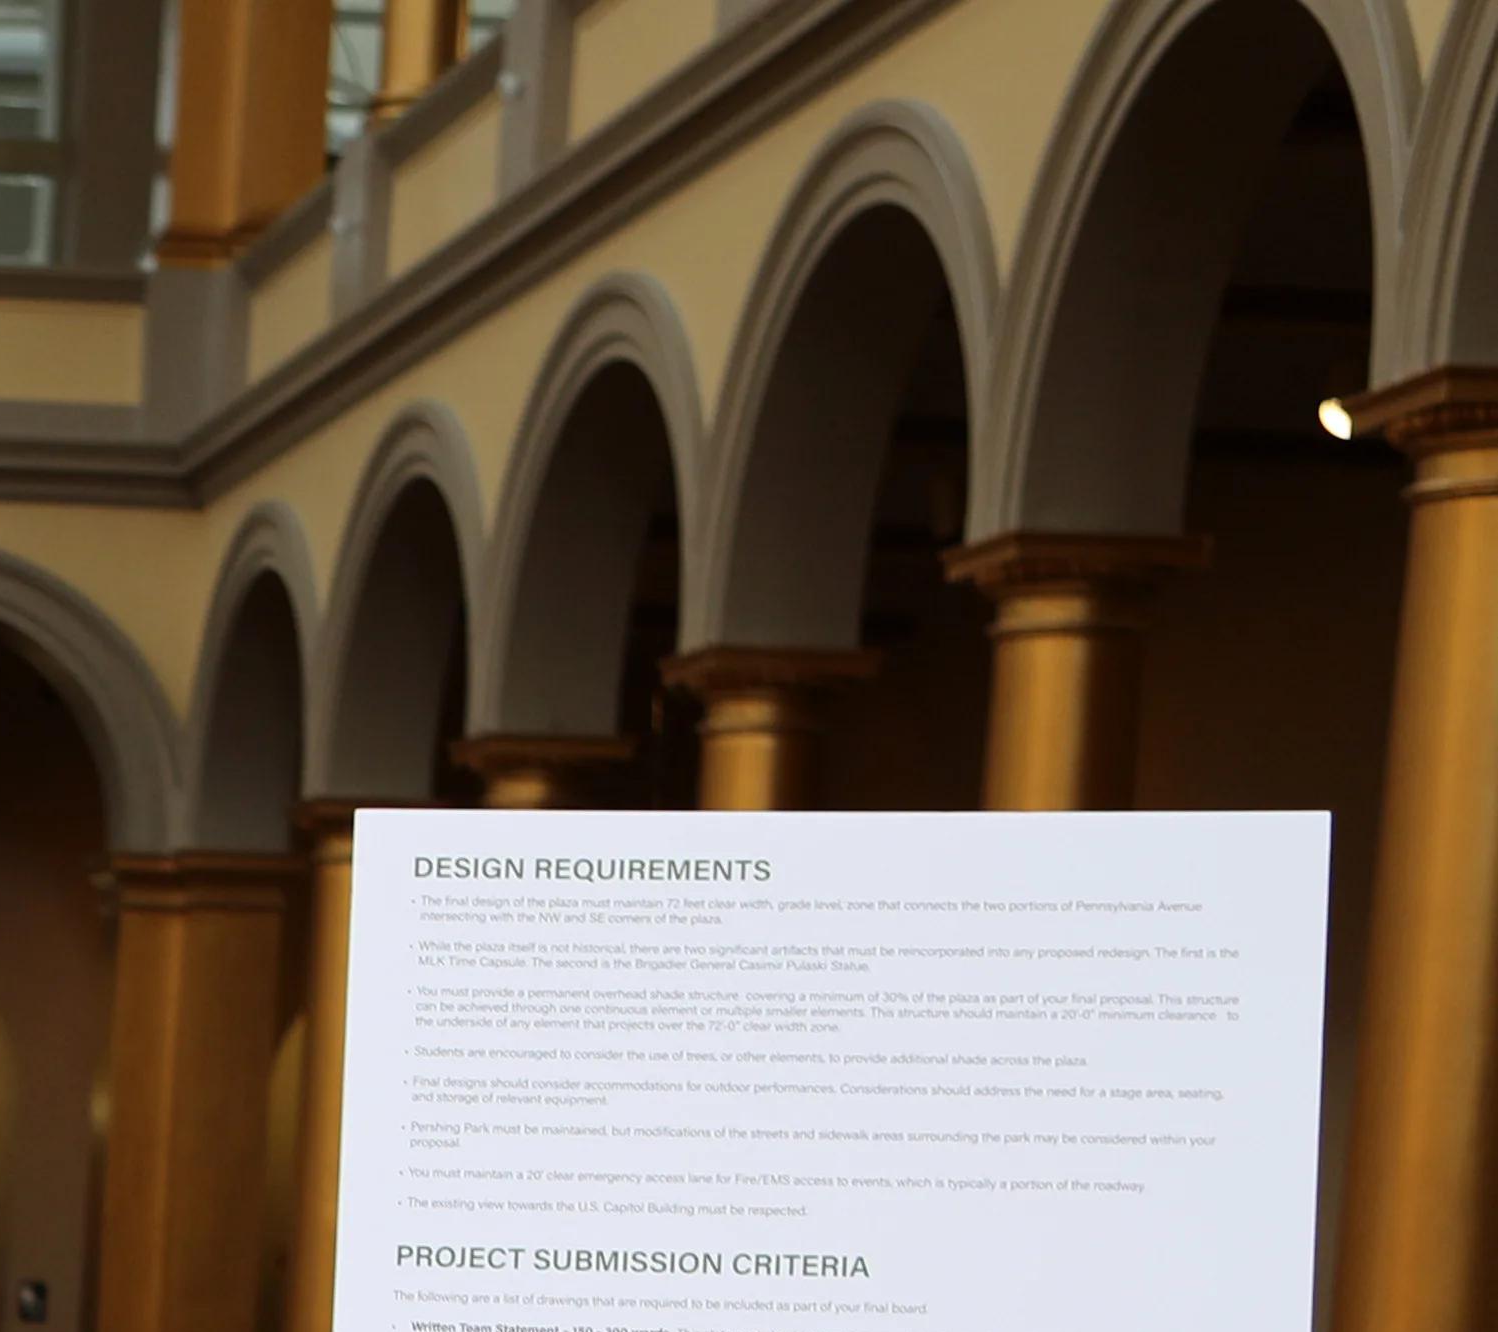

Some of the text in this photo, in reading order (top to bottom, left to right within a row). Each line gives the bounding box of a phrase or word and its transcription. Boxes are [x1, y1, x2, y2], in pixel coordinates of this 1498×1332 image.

[414, 856, 771, 883] DESIGN REQUIREMENTS
[396, 1244, 870, 1278] PROJECT SUBMISSION CRITERIA
